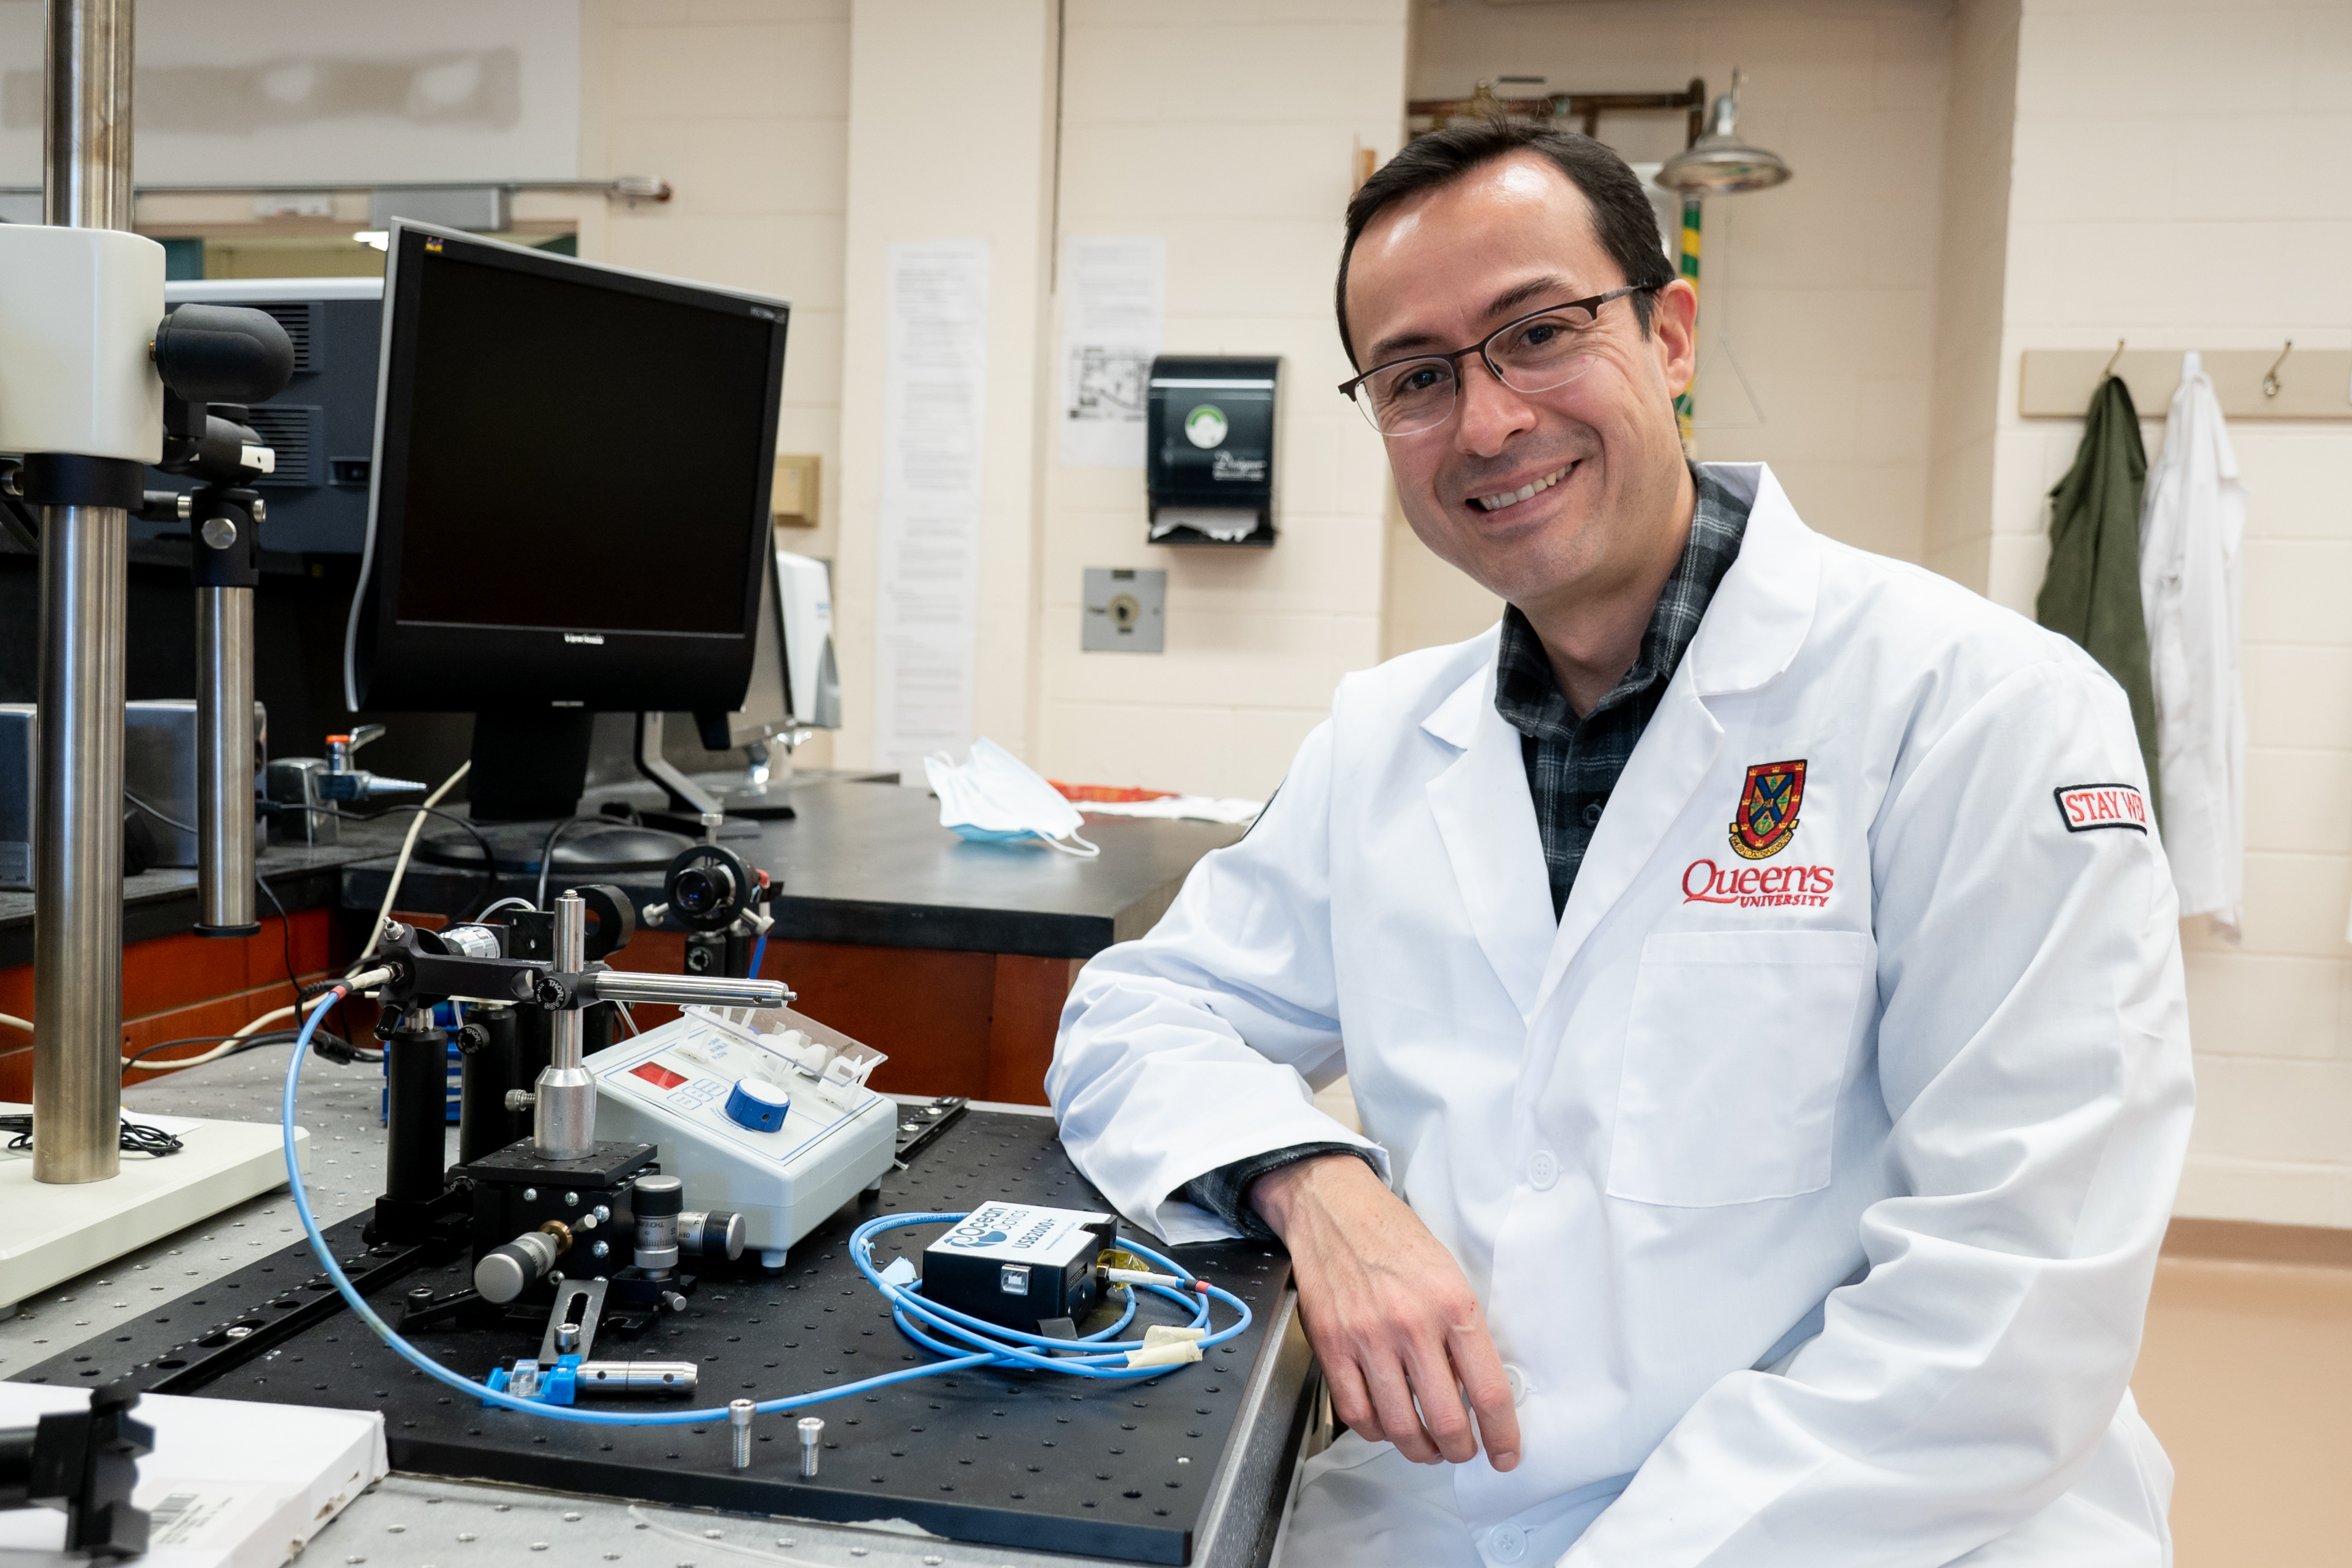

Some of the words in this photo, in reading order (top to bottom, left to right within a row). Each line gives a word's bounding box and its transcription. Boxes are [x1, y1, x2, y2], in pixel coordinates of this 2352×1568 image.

[2066, 791, 2121, 822] STAY
[1682, 859, 1834, 904] Queen's
[1740, 894, 1829, 908] UNIVERSITY
[544, 979, 564, 1010] THORLABS
[956, 1207, 1008, 1235] Ocean
[991, 1209, 1030, 1230] Optics
[1012, 1218, 1056, 1249] USB2000+
